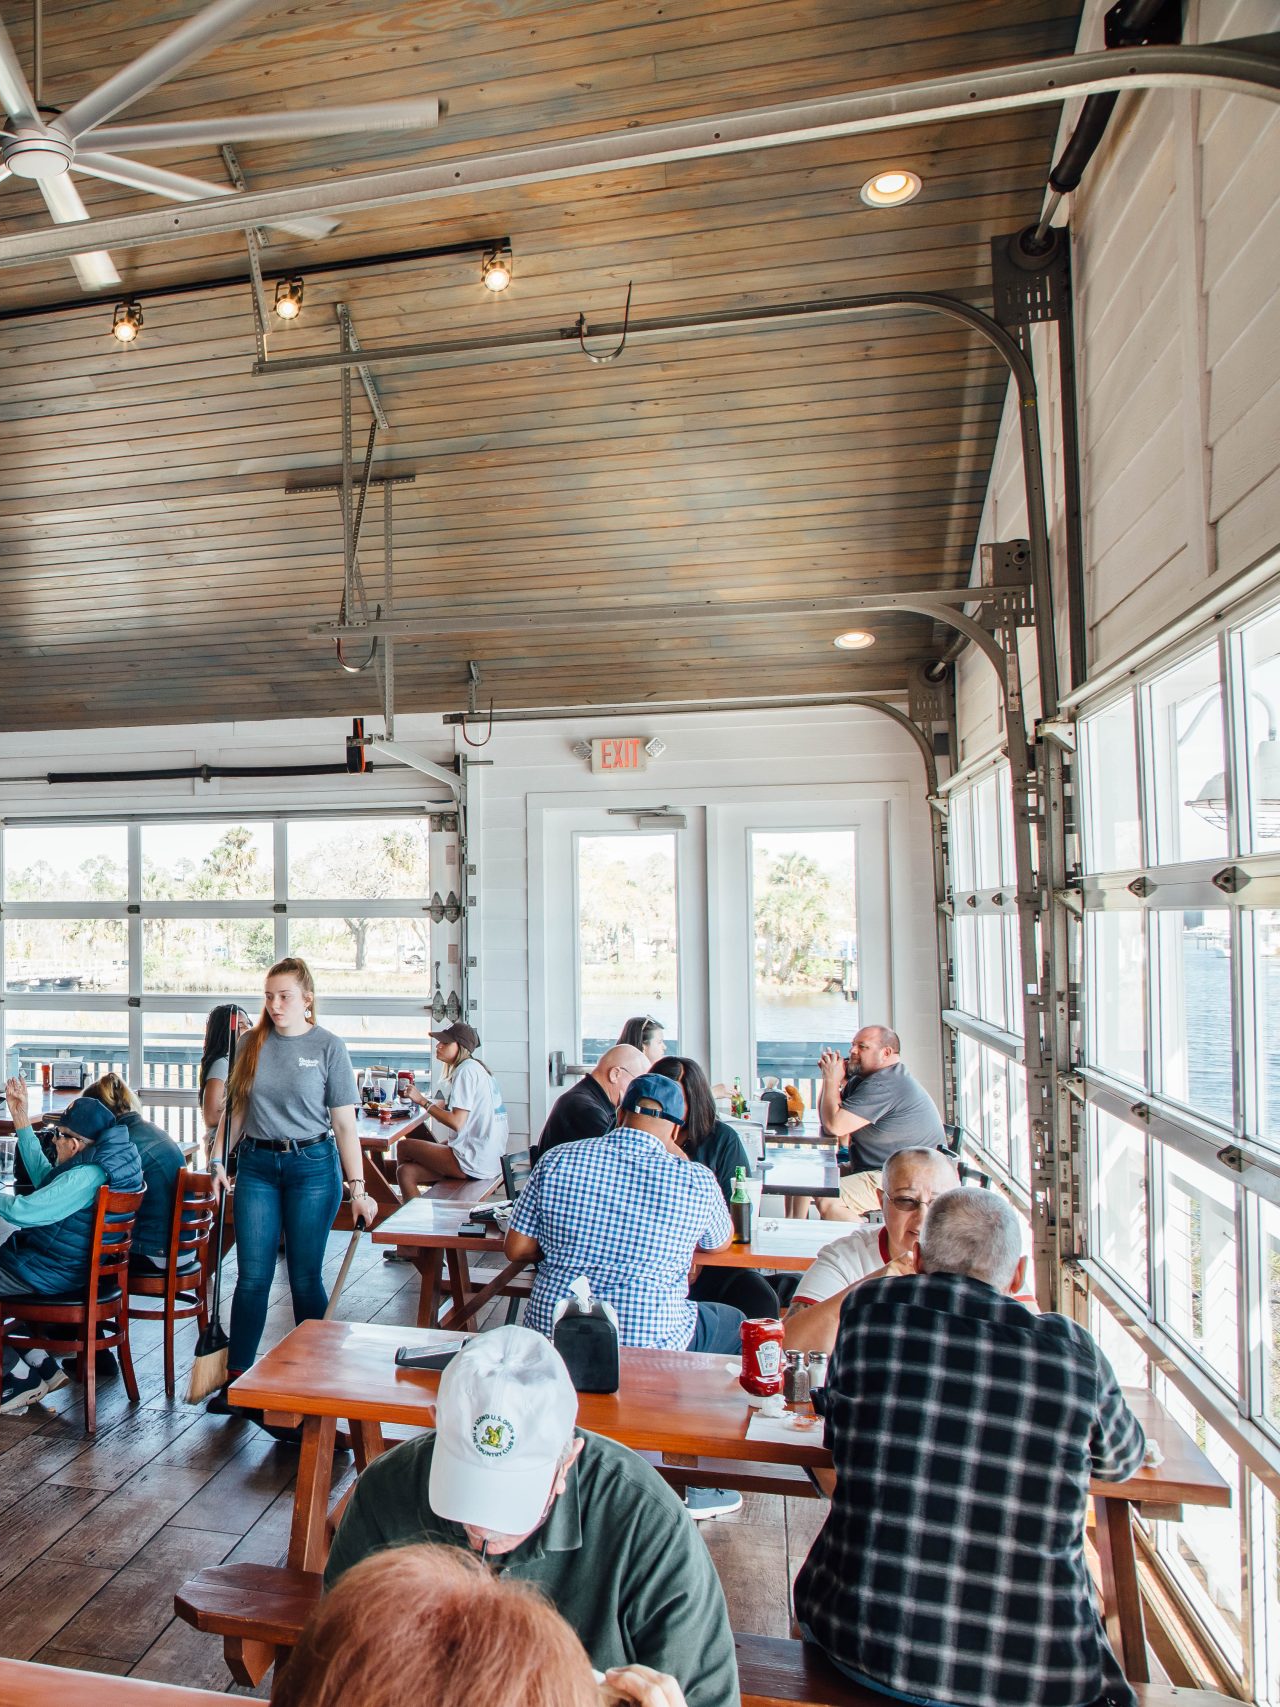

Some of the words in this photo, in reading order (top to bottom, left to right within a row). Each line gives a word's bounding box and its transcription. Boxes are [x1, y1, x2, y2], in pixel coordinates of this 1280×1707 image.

[601, 739, 640, 769] EXIT
[476, 1444, 502, 1457] COUNTRY
[502, 1441, 514, 1454] CLUB
